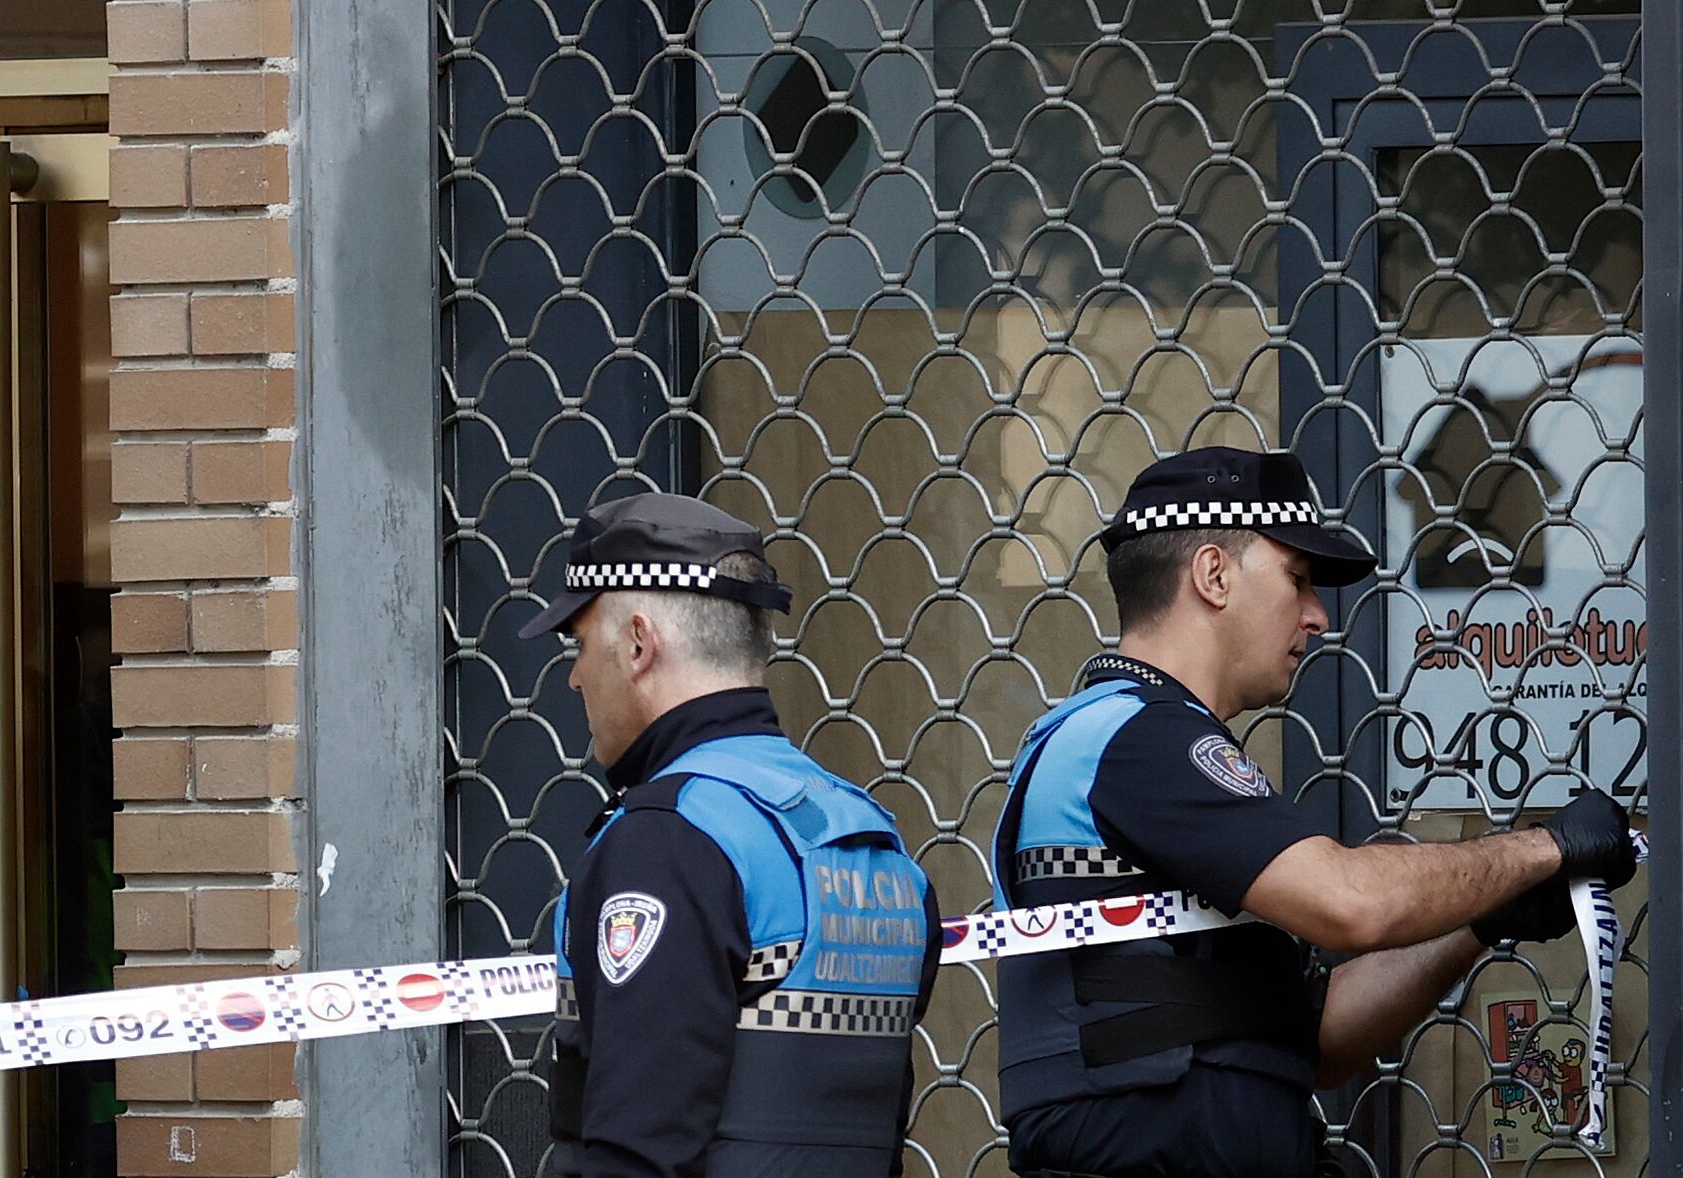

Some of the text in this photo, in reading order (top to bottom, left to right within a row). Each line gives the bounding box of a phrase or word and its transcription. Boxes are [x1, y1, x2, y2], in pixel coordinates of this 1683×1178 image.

[1581, 682, 1607, 698] DE
[1394, 710, 1530, 801] 948
[480, 962, 557, 999] POLIC
[90, 1010, 175, 1046] 092
